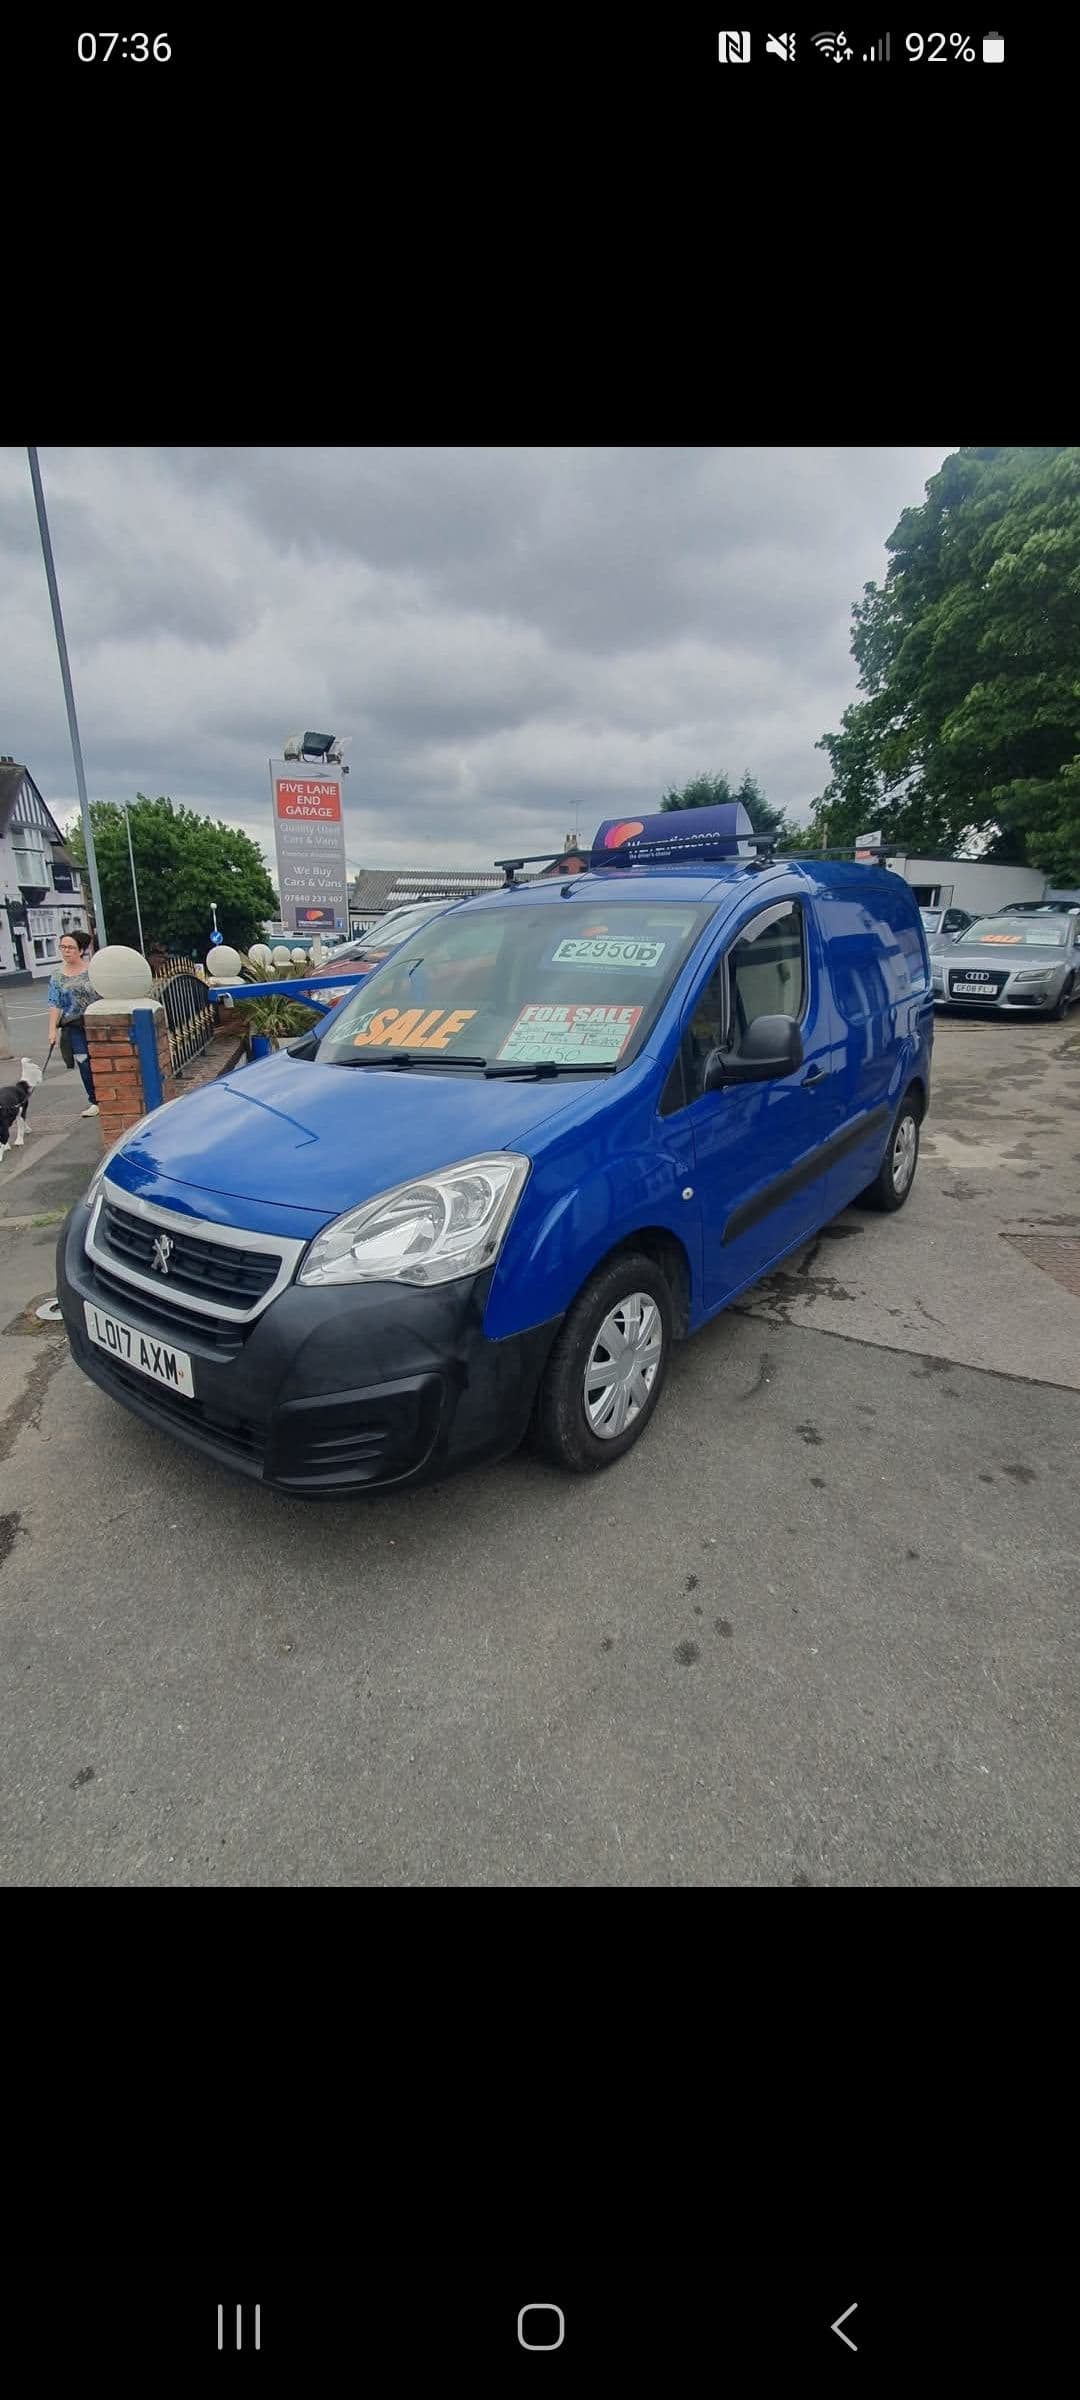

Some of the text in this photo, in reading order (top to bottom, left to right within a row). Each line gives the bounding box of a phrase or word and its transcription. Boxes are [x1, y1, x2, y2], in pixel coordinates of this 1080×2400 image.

[280, 783, 336, 795] FIVE LANE
[297, 795, 320, 805] END
[286, 806, 333, 817] GARAGE
[293, 865, 331, 878] We Buy
[284, 878, 305, 886] Cars
[318, 879, 342, 887] Vans
[520, 1007, 633, 1023] FOR SALE
[353, 1008, 478, 1048] SALE
[140, 1338, 179, 1385] AXM
